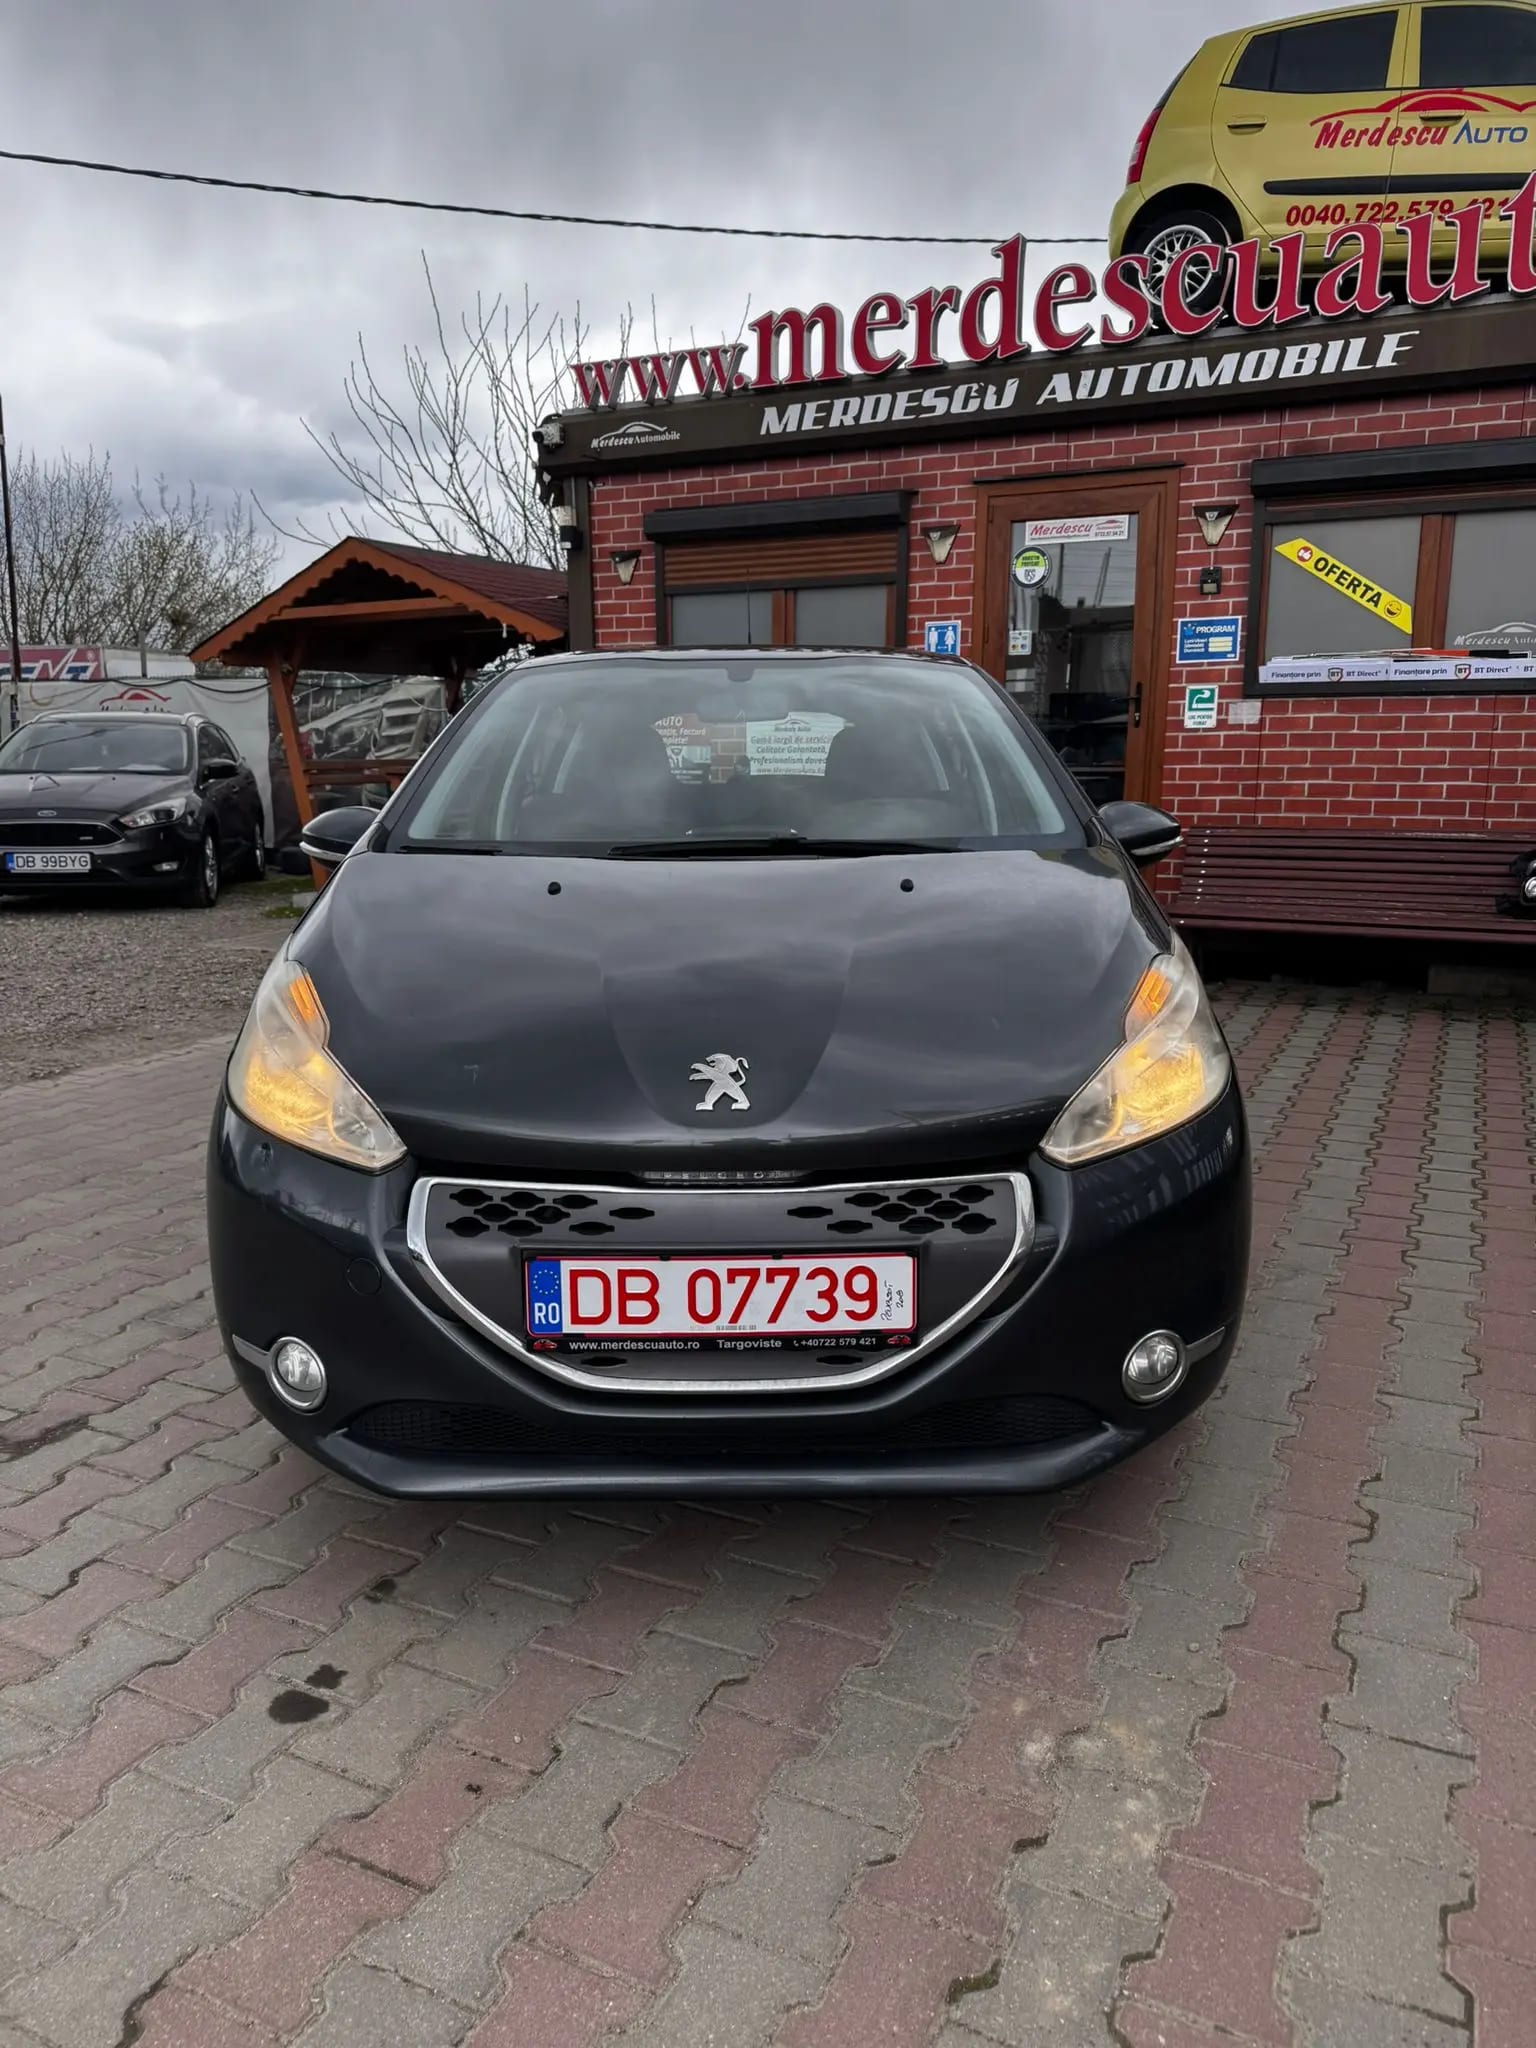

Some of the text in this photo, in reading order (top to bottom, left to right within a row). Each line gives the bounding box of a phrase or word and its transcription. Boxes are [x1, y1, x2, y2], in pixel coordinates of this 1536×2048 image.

[1314, 117, 1449, 149] Merdescu
[760, 330, 1420, 435] MERDESCU AUTOMOBILE
[1030, 523, 1093, 537] Merdescu
[1314, 557, 1382, 608] OFERTA
[1195, 625, 1236, 634] PROGRAM
[1454, 635, 1511, 646] Merdescu
[1307, 671, 1321, 679] prin
[15, 856, 36, 869] DB
[41, 855, 89, 869] 99BYG
[569, 1265, 878, 1326] DB 07739
[534, 1303, 560, 1325] RO
[569, 1337, 876, 1350] www.merdescuauto.ro Targoviste +40722 579 421
